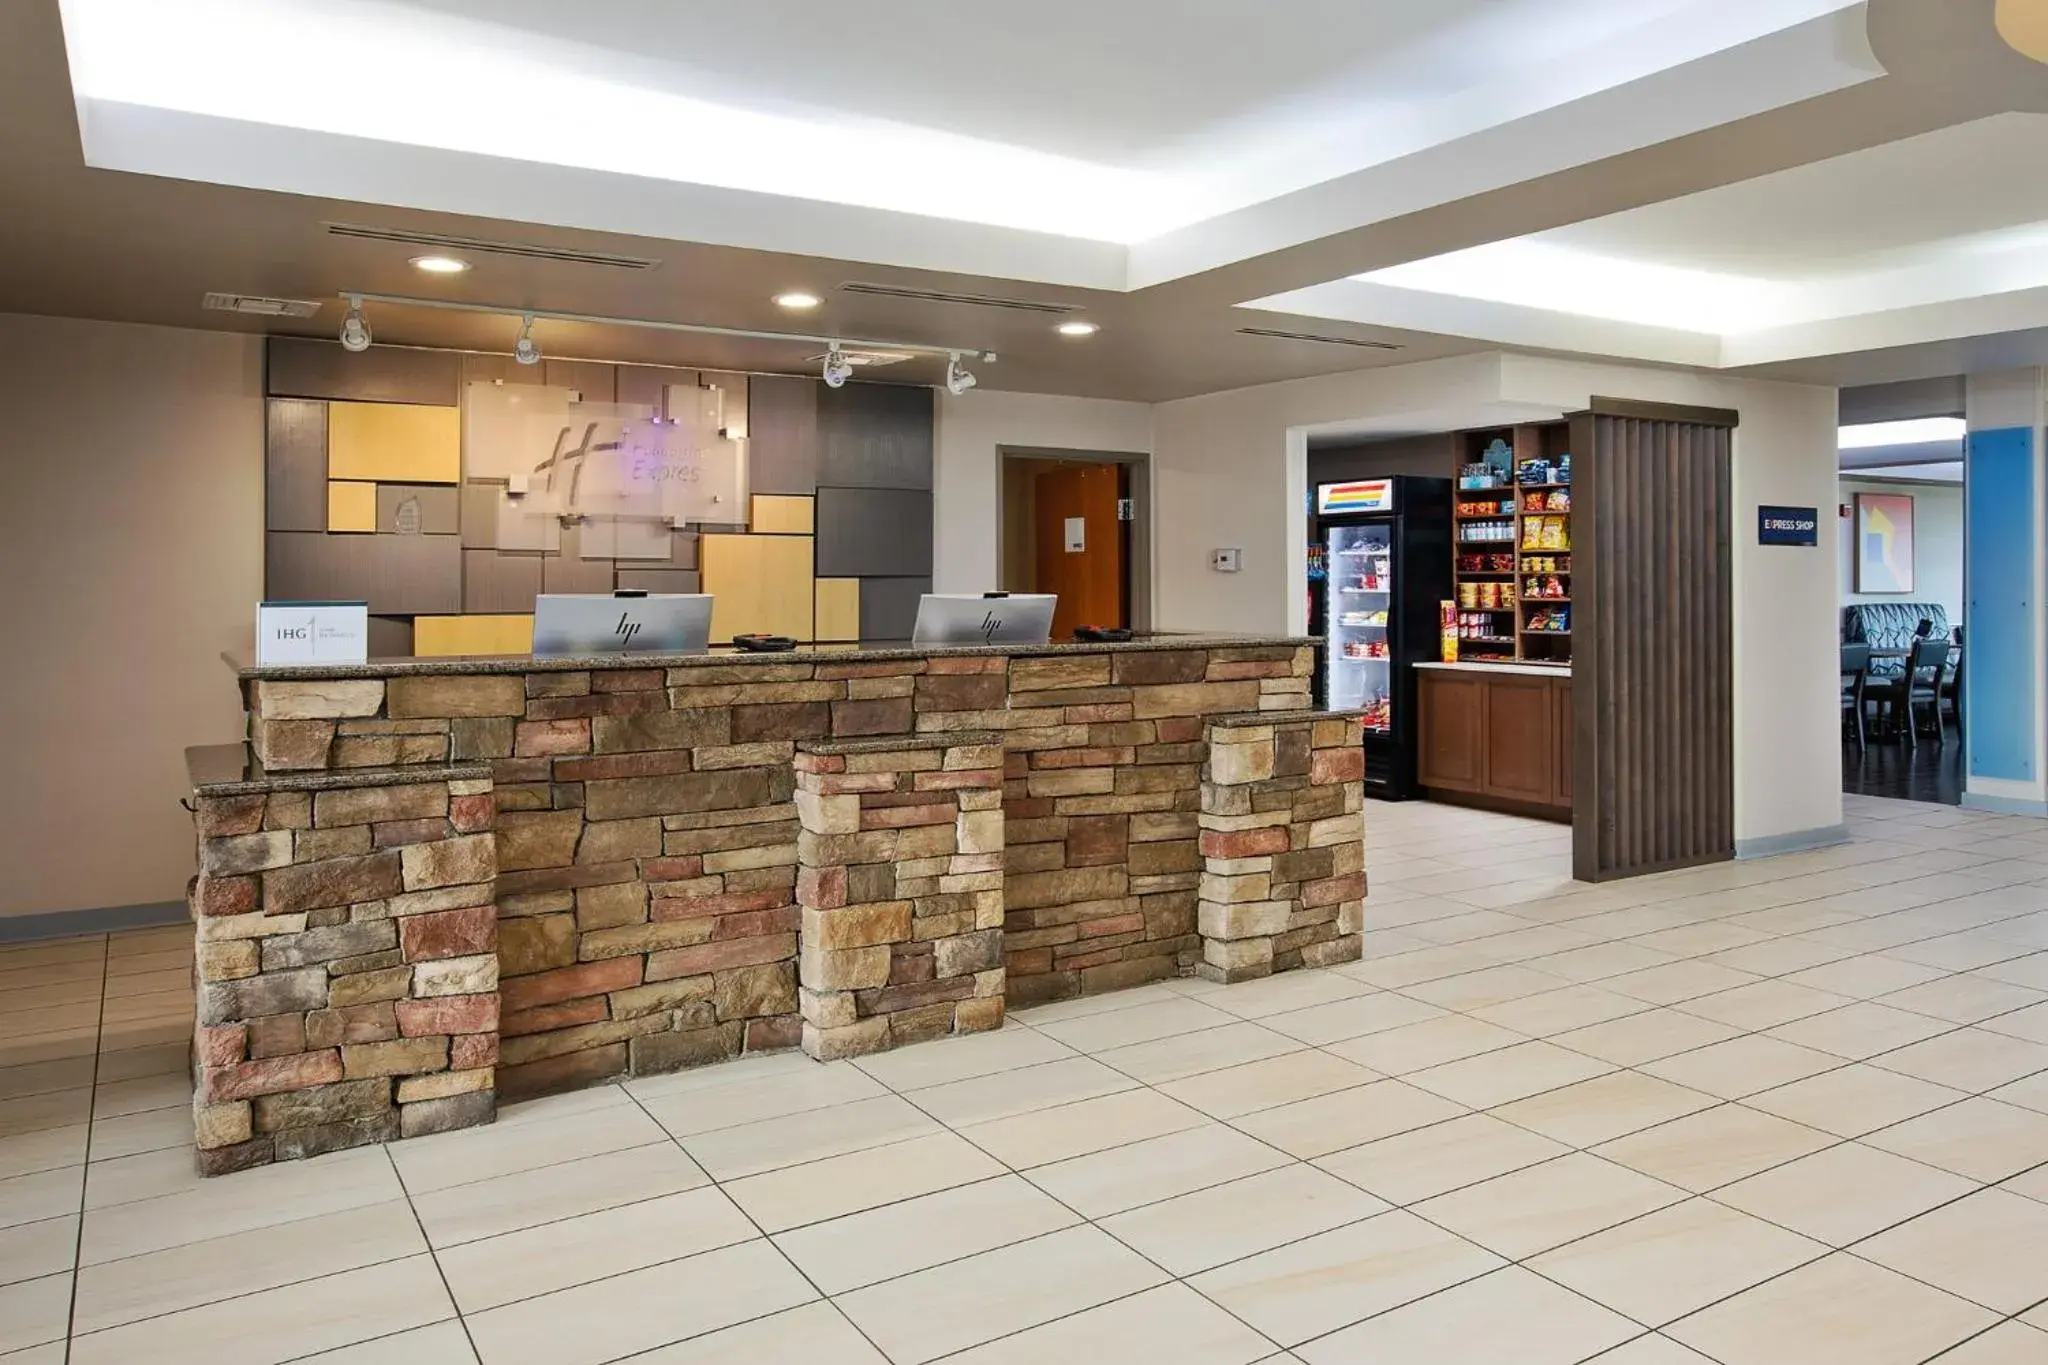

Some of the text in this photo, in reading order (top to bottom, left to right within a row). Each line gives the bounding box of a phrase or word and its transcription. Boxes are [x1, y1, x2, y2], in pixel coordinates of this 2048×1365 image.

[1795, 520, 1814, 530] SHOP
[277, 628, 307, 640] IHG
[615, 612, 641, 645] hp
[980, 610, 1002, 639] hp
